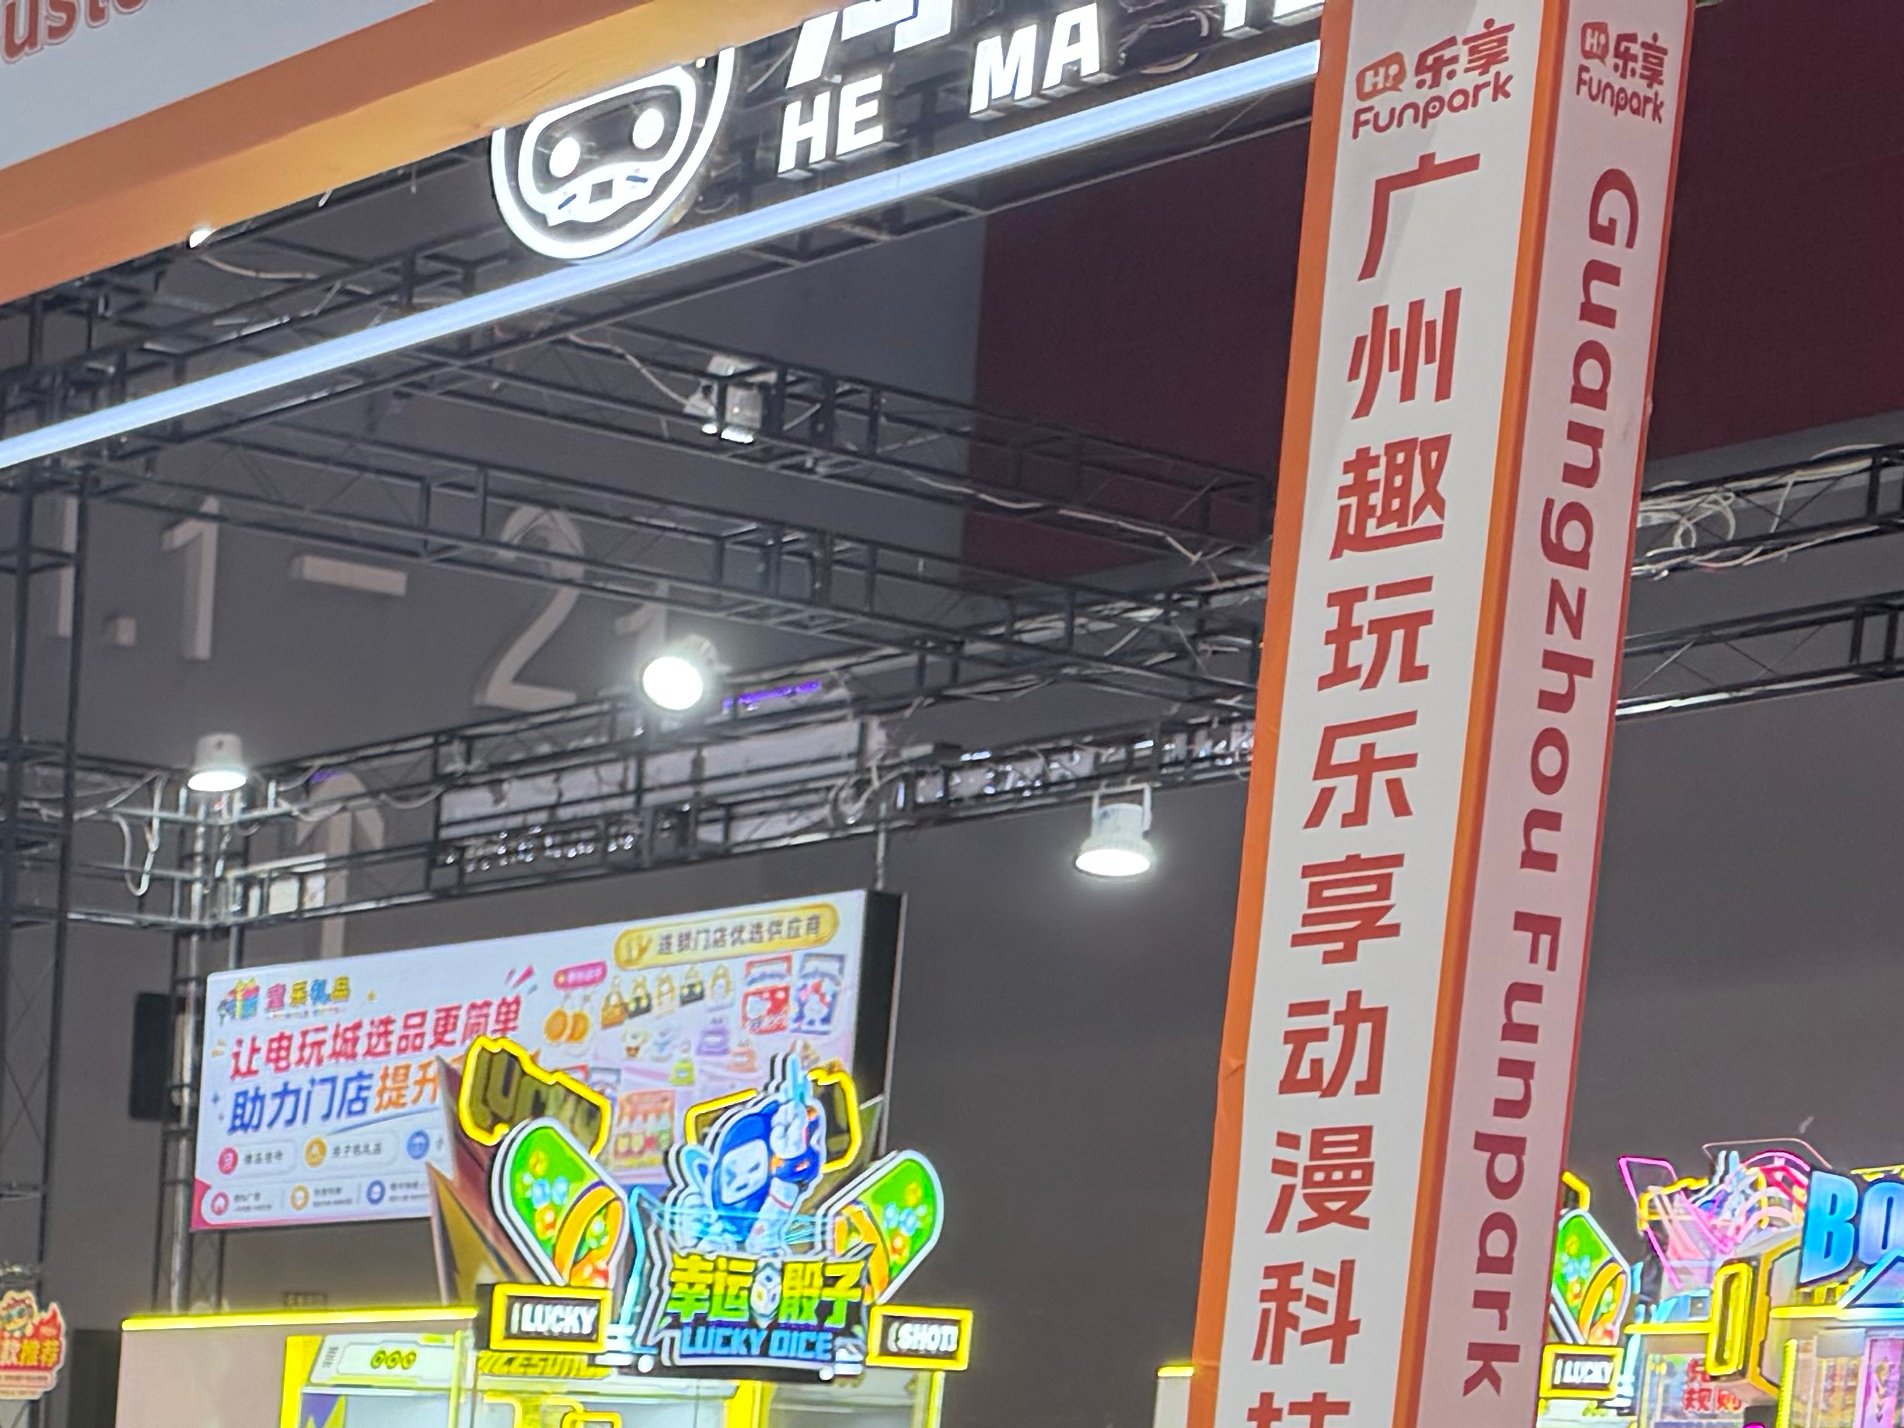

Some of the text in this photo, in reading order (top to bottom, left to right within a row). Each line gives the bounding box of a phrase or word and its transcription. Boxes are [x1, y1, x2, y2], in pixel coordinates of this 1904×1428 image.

[1414, 18, 1516, 89] 乐享
[1612, 32, 1669, 88] 乐享
[777, 73, 885, 176] HE
[969, 3, 1103, 115] MA
[1352, 72, 1514, 139] Funpark
[1576, 64, 1664, 124] Funpark
[1520, 167, 1640, 873] Guangzhou
[657, 913, 823, 957] 连锁门店优选供应商
[229, 993, 523, 1083] 让电玩城选品更简单
[1463, 910, 1562, 1398] Funpark
[665, 1253, 867, 1329] 幸运骰子
[677, 1327, 835, 1362] LUCKY DICE
